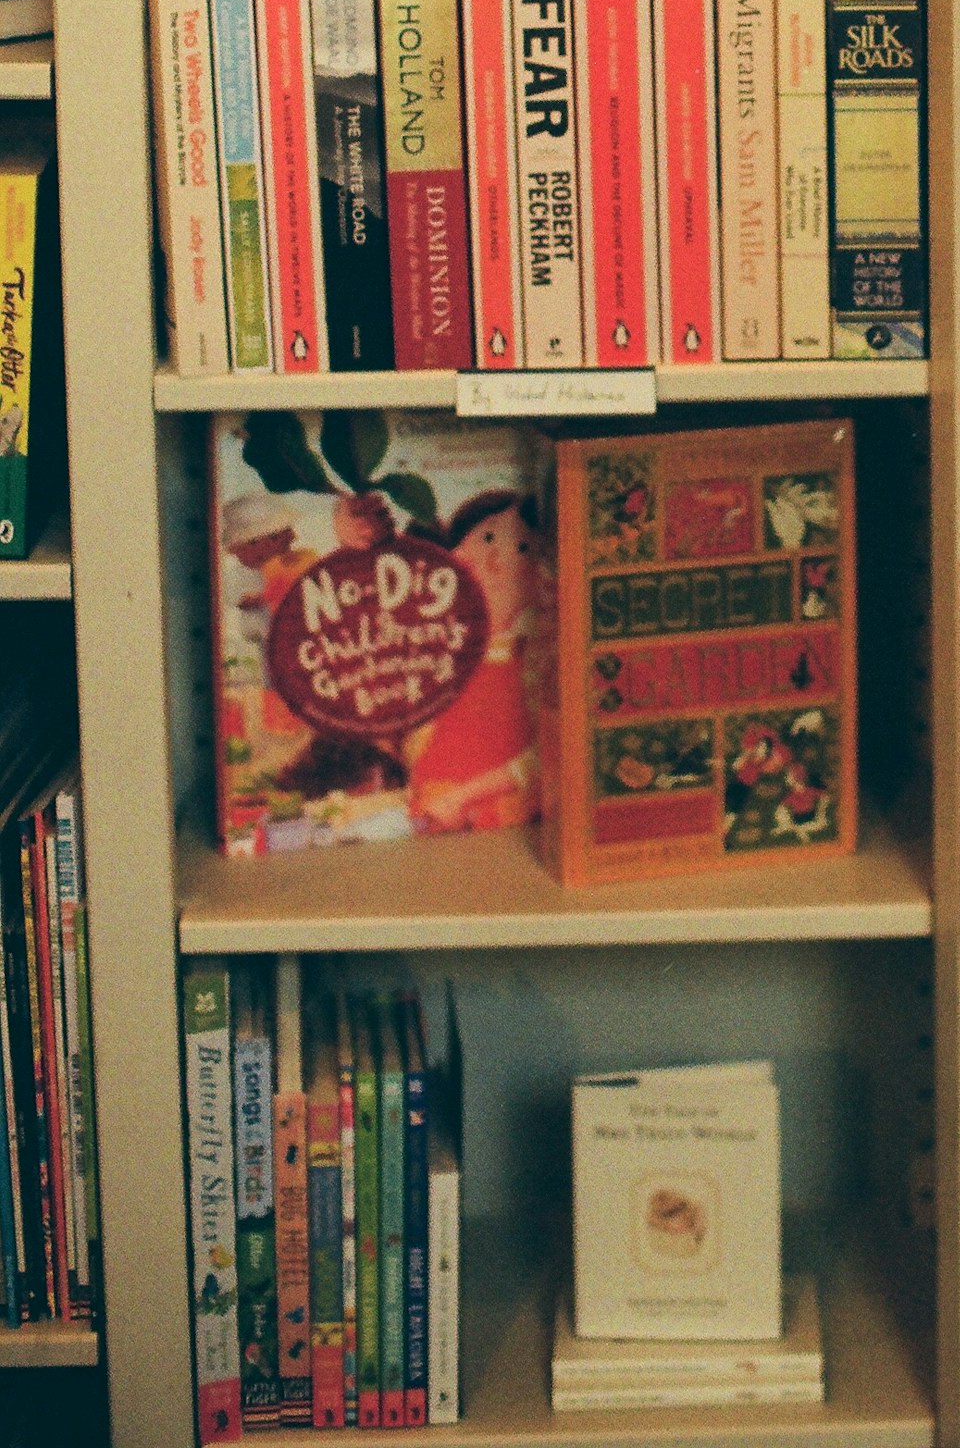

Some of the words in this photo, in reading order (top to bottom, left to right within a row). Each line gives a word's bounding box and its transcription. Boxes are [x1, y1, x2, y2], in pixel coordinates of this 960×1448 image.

[182, 9, 203, 51] Two
[847, 25, 903, 50] SILK
[866, 13, 886, 25] THE
[185, 54, 205, 124] Wheels
[396, 4, 425, 156] HOLLAND
[429, 56, 446, 101] TOM
[838, 47, 915, 75] ROADS
[346, 105, 362, 137] THE
[189, 129, 209, 188] Good
[348, 142, 363, 193] WHITE
[737, 129, 763, 189] Sam
[188, 216, 208, 253] Jody
[351, 198, 366, 245] ROAD
[527, 173, 551, 286] PECKHAM
[551, 171, 574, 262] ROBERT
[738, 198, 765, 287] Miller
[192, 257, 208, 304] Rosen
[425, 184, 451, 337] DOMINION
[2, 267, 25, 335] Tarka
[0, 347, 25, 393] Otter
[303, 552, 458, 633] No-Dig
[597, 565, 788, 633] SECRET
[197, 1046, 226, 1164] Butterfly
